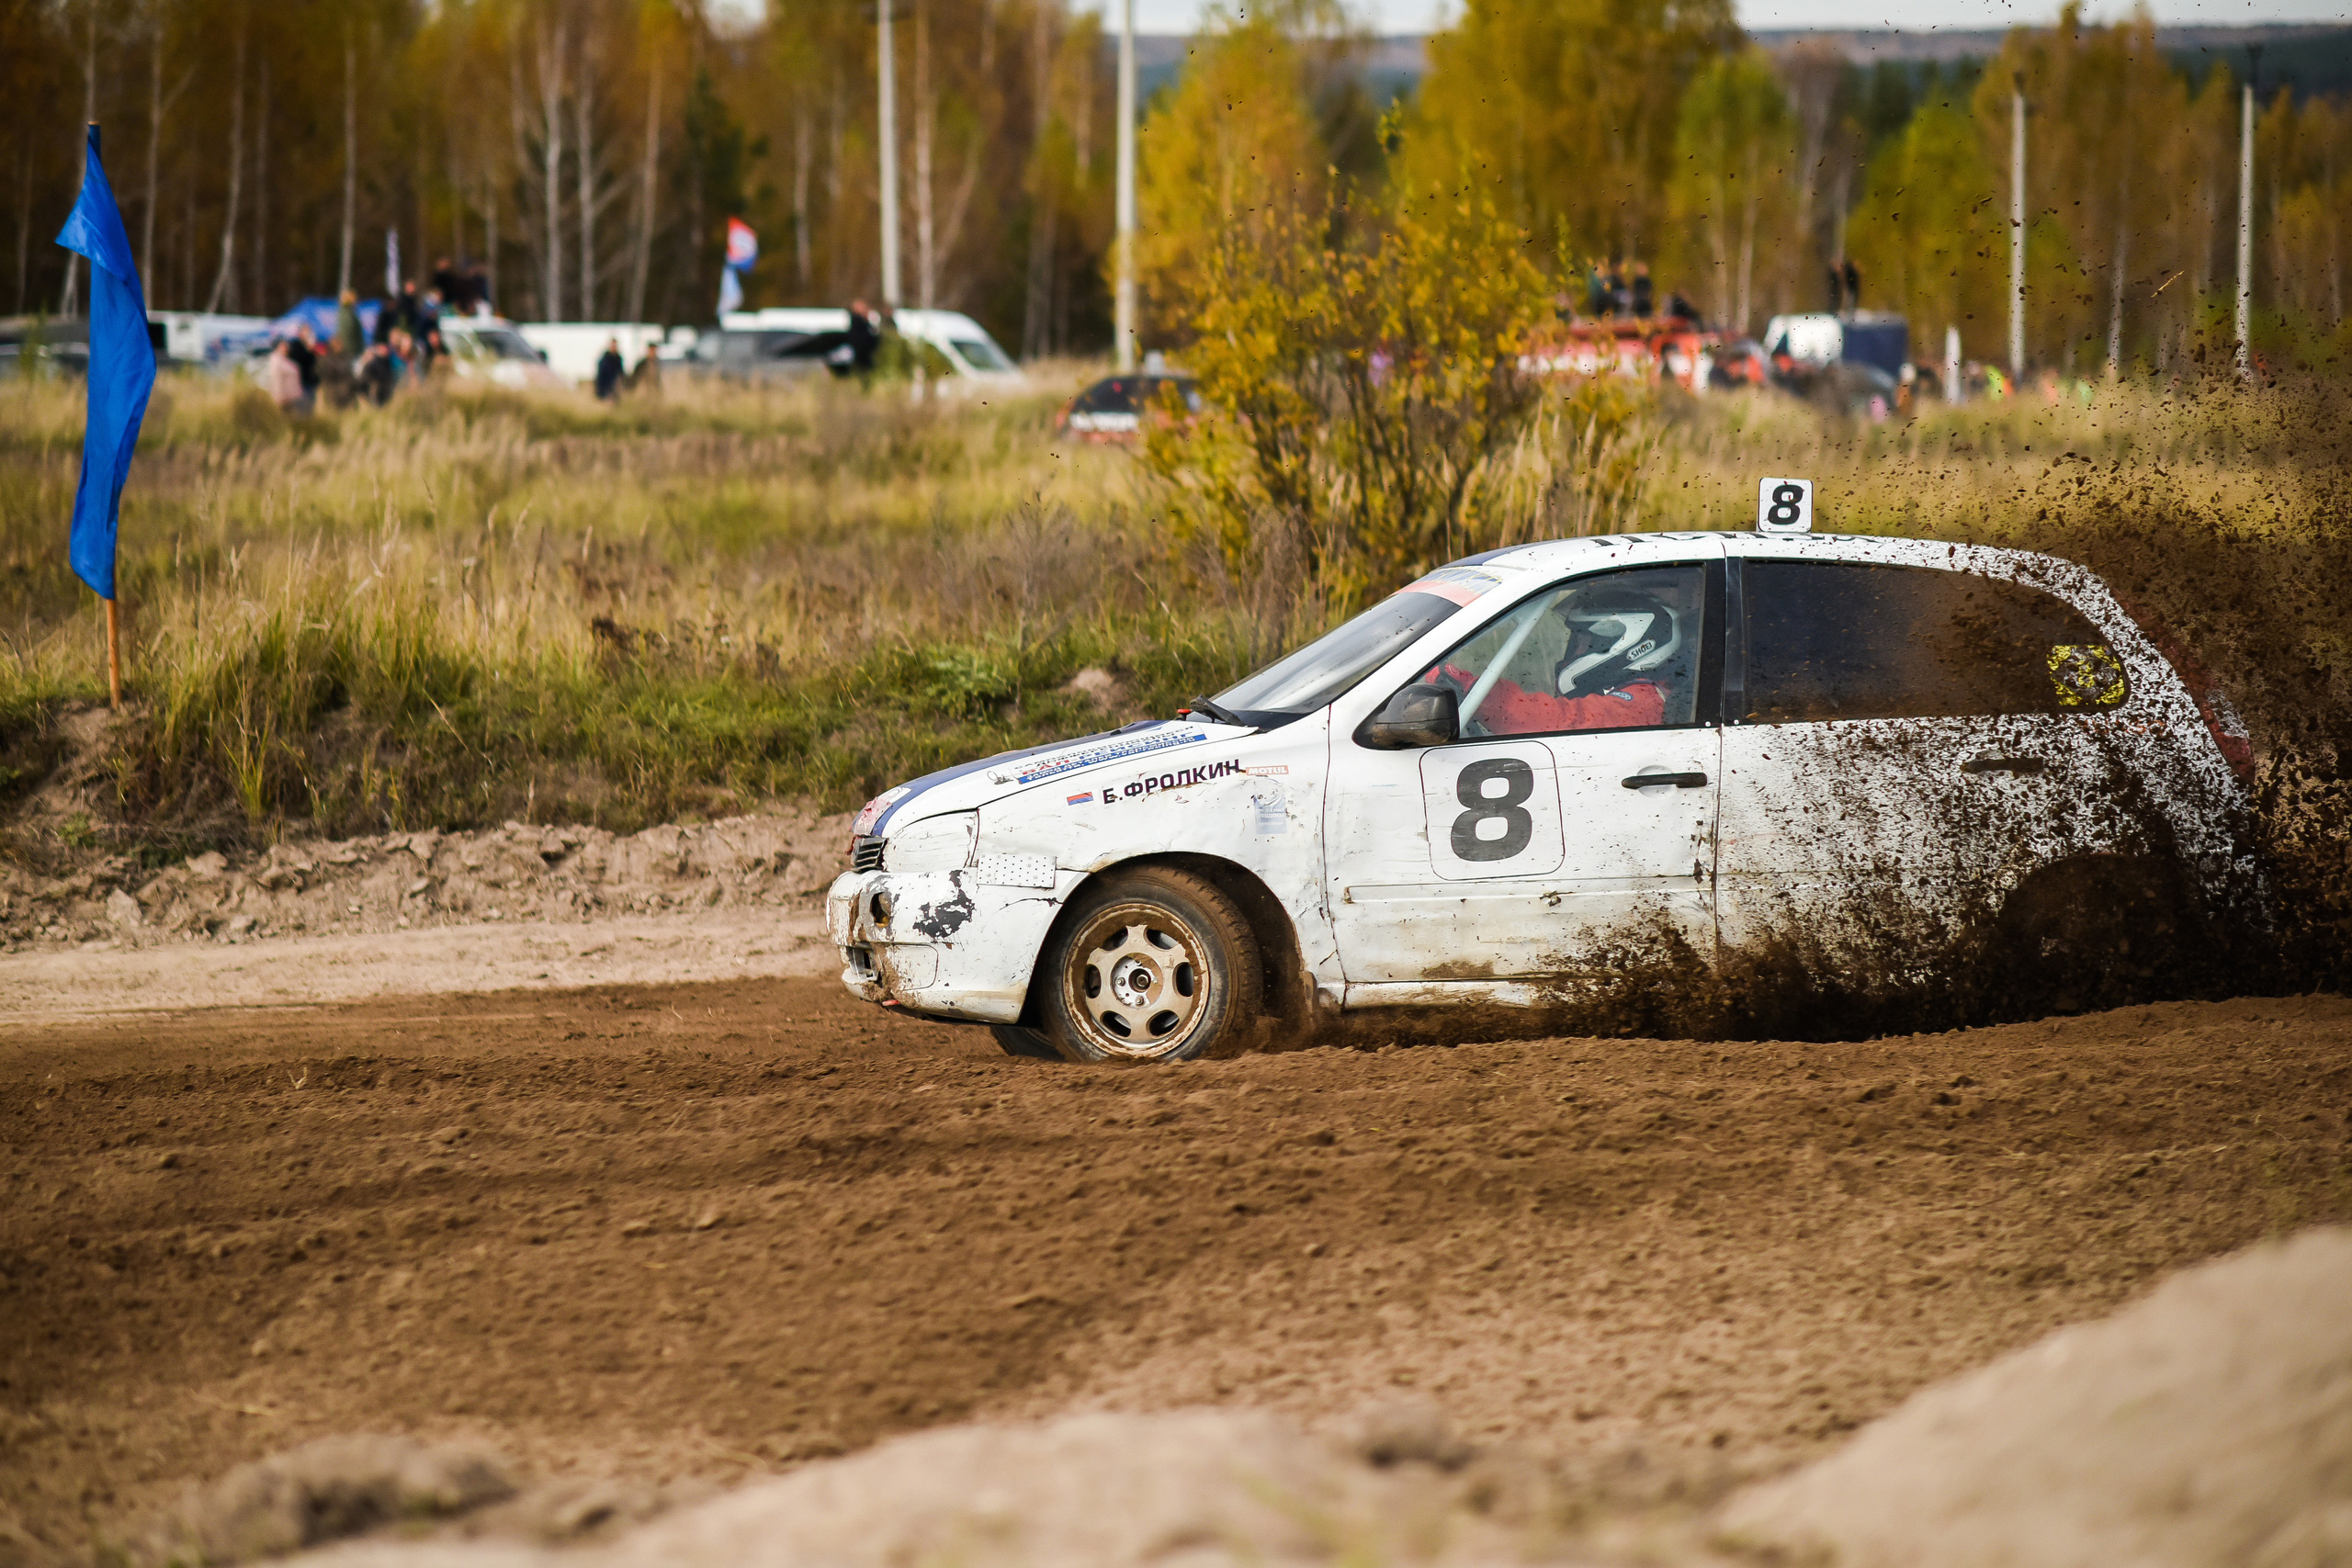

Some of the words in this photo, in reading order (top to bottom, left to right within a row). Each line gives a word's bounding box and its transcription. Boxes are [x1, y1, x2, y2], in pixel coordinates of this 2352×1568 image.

[1768, 484, 1804, 525] 8
[1631, 642, 1652, 658] SHOEI
[1451, 758, 1534, 862] 8
